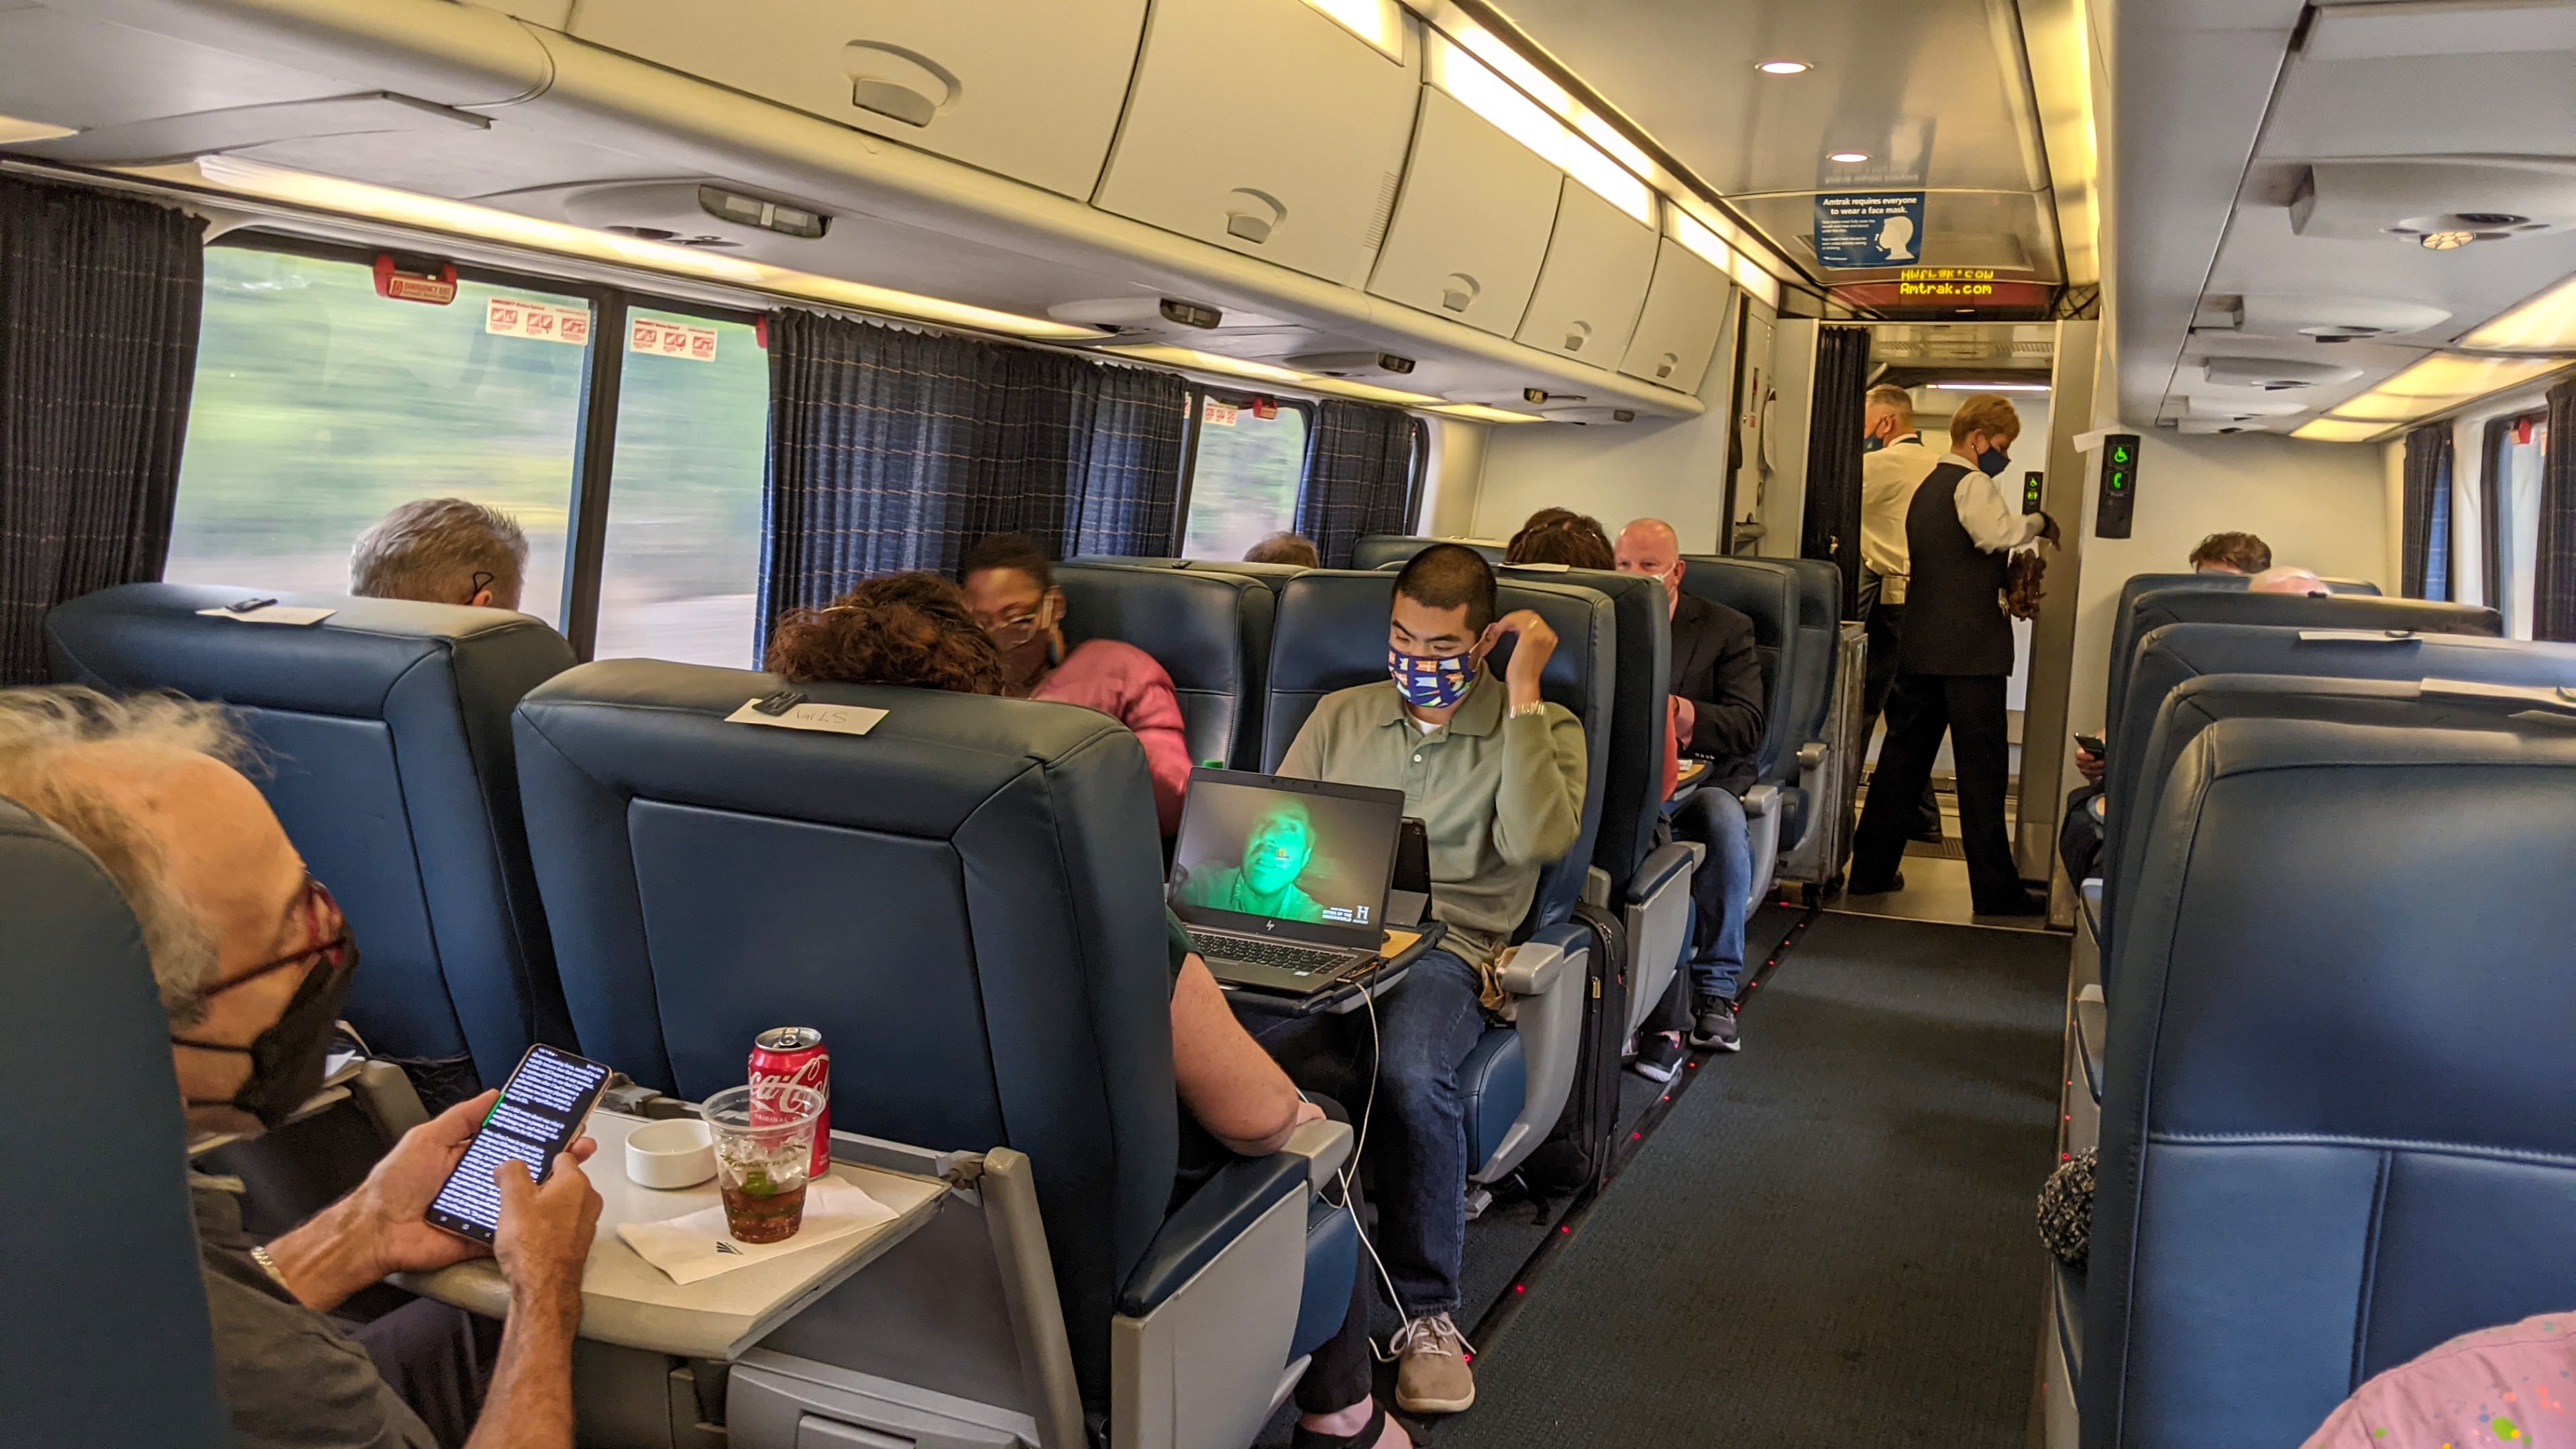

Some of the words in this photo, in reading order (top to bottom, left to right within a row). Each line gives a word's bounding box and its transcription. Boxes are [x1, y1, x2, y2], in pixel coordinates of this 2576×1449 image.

[1851, 197, 1881, 206] requires
[1882, 197, 1917, 206] everyone
[1900, 282, 1992, 294] Amtrak.com
[1356, 905, 1370, 920] H
[753, 1113, 788, 1123] ORIGINAL
